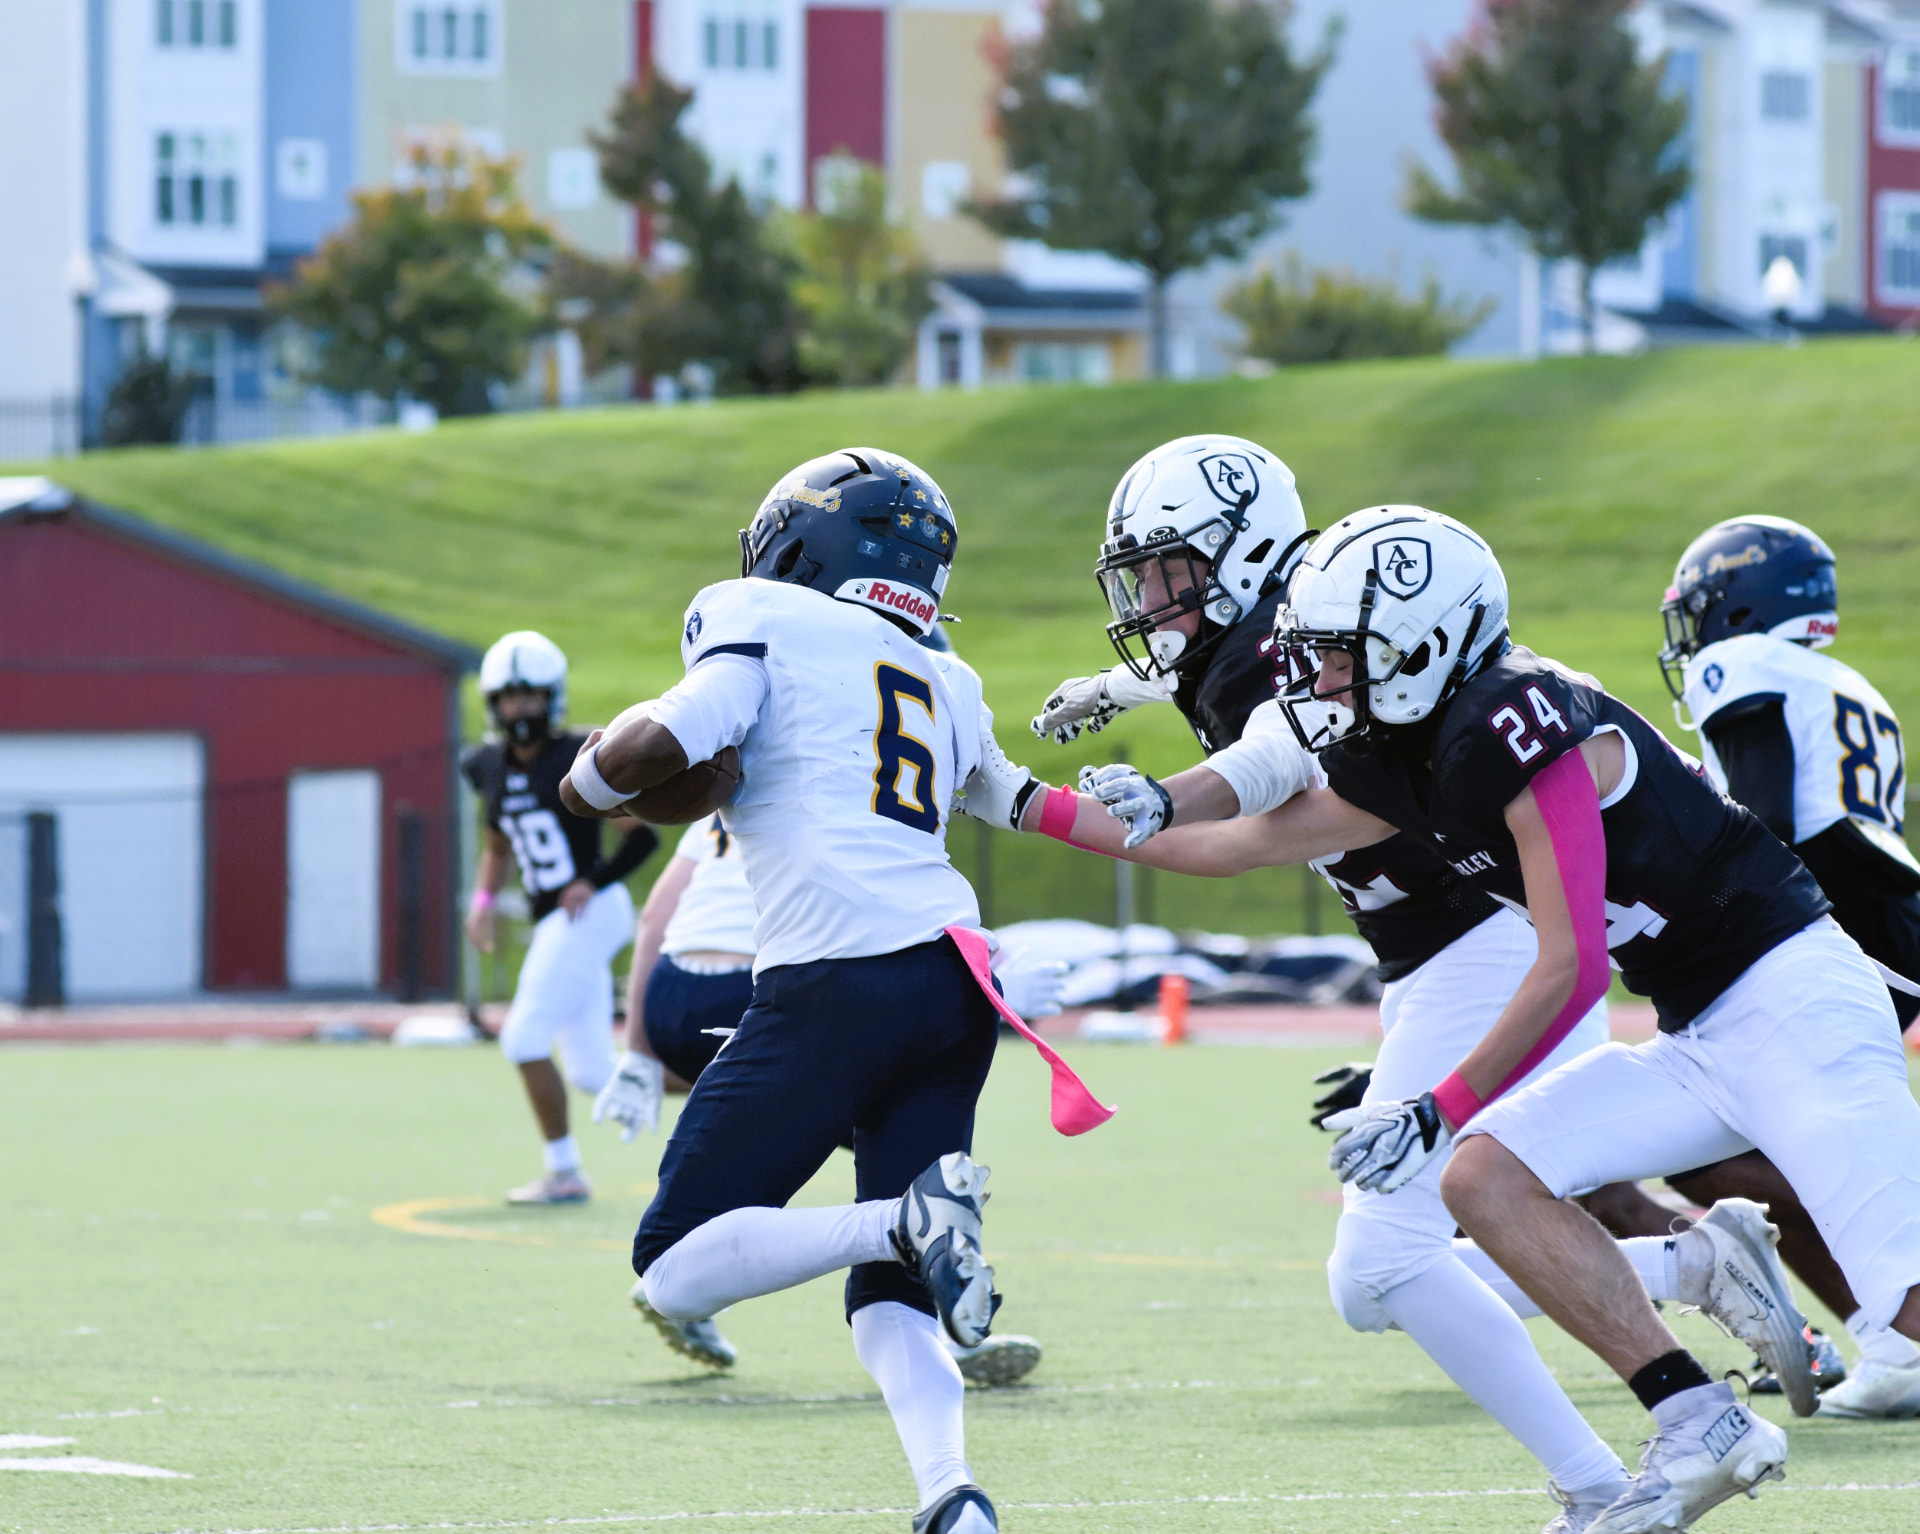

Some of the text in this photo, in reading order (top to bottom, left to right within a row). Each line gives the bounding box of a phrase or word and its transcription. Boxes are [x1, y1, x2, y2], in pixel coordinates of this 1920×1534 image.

[867, 581, 936, 624] Riddell
[870, 660, 941, 836] 6
[1488, 681, 1573, 769] 24
[498, 808, 576, 896] 19
[1702, 1406, 1751, 1462] NIKE
